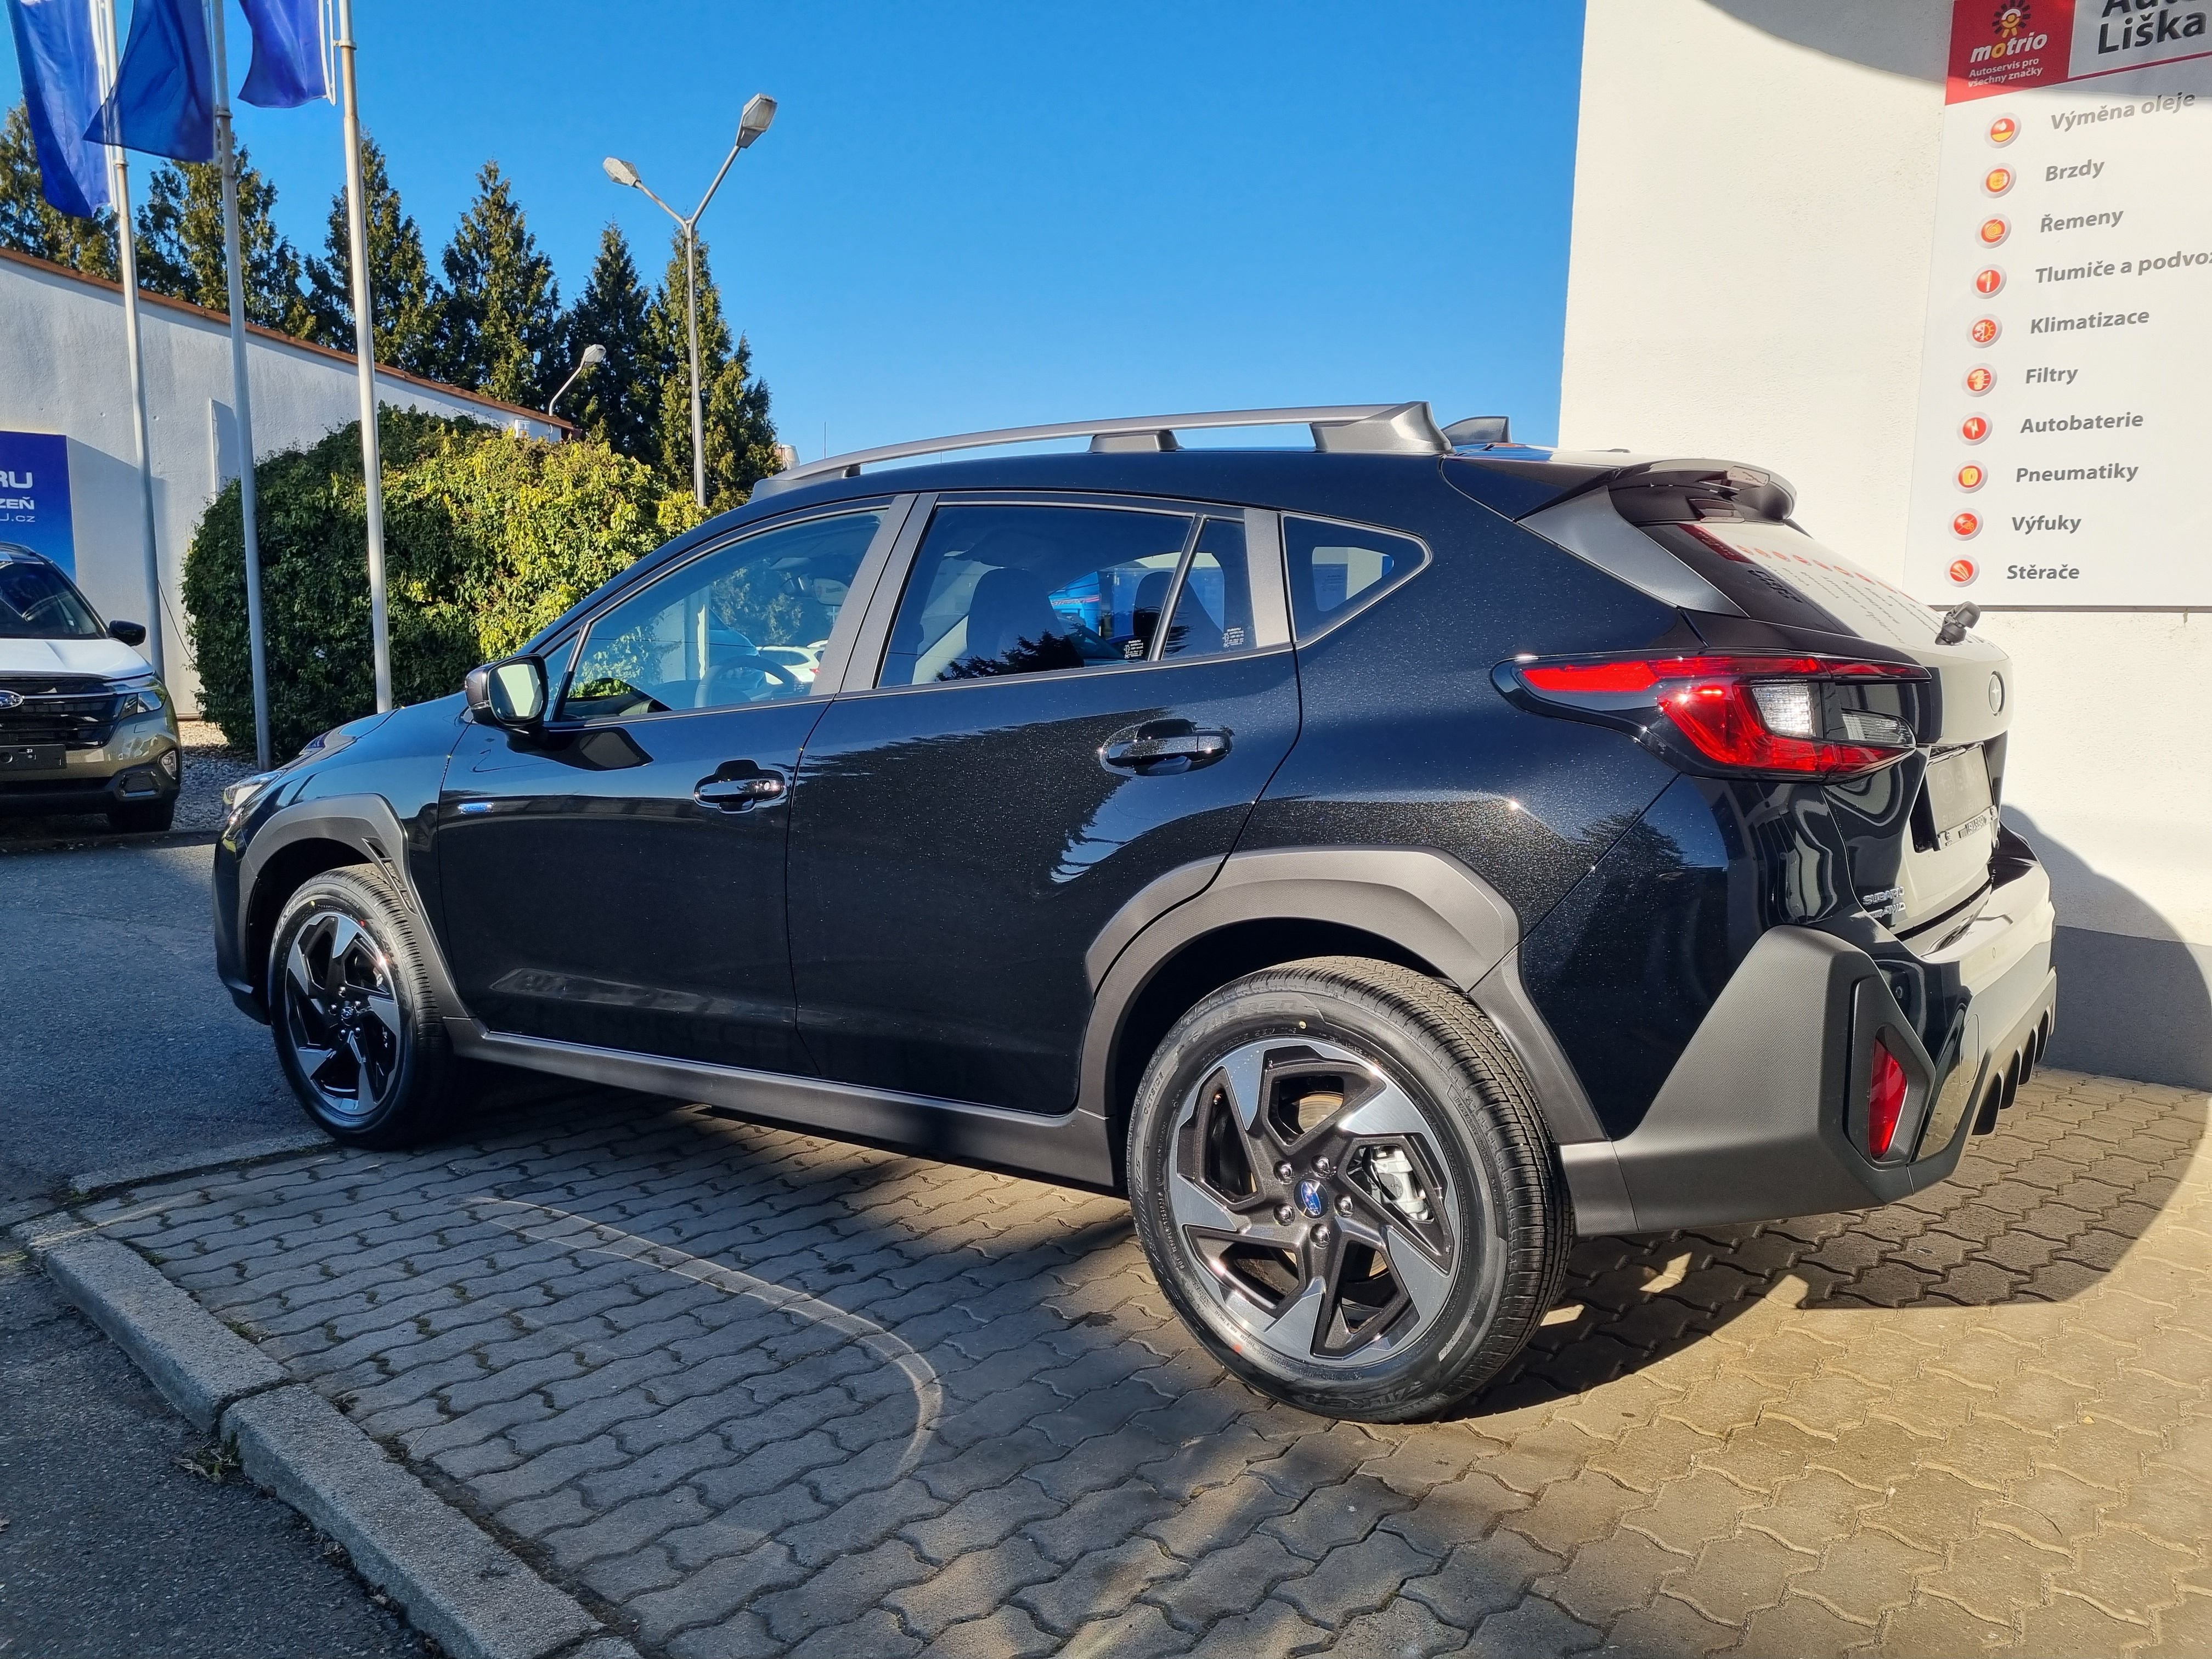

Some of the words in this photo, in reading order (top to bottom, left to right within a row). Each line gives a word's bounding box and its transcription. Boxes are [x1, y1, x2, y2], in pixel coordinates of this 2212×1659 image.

[2098, 9, 2207, 54] Liška
[1970, 32, 2048, 63] motrio
[1968, 74, 2007, 88] všechny
[2008, 67, 2043, 80] značky
[1969, 60, 2020, 78] Autoservis
[2022, 58, 2039, 69] pro
[2051, 104, 2135, 132] Výměna
[2141, 92, 2196, 114] oleje
[2045, 159, 2104, 182] Brzdy
[2040, 211, 2124, 233] Řemeny
[2035, 261, 2115, 284] Tlumiče
[2120, 261, 2132, 273] a
[2030, 311, 2149, 334] Klimatizace
[2025, 367, 2079, 385] Filtry
[2020, 411, 2144, 433] Autobaterie
[2016, 463, 2139, 482] Pneumatiky
[2012, 515, 2082, 535] Výfuky
[2007, 564, 2080, 580] Stěrače
[1143, 1070, 1165, 1115] OUTSIDE
